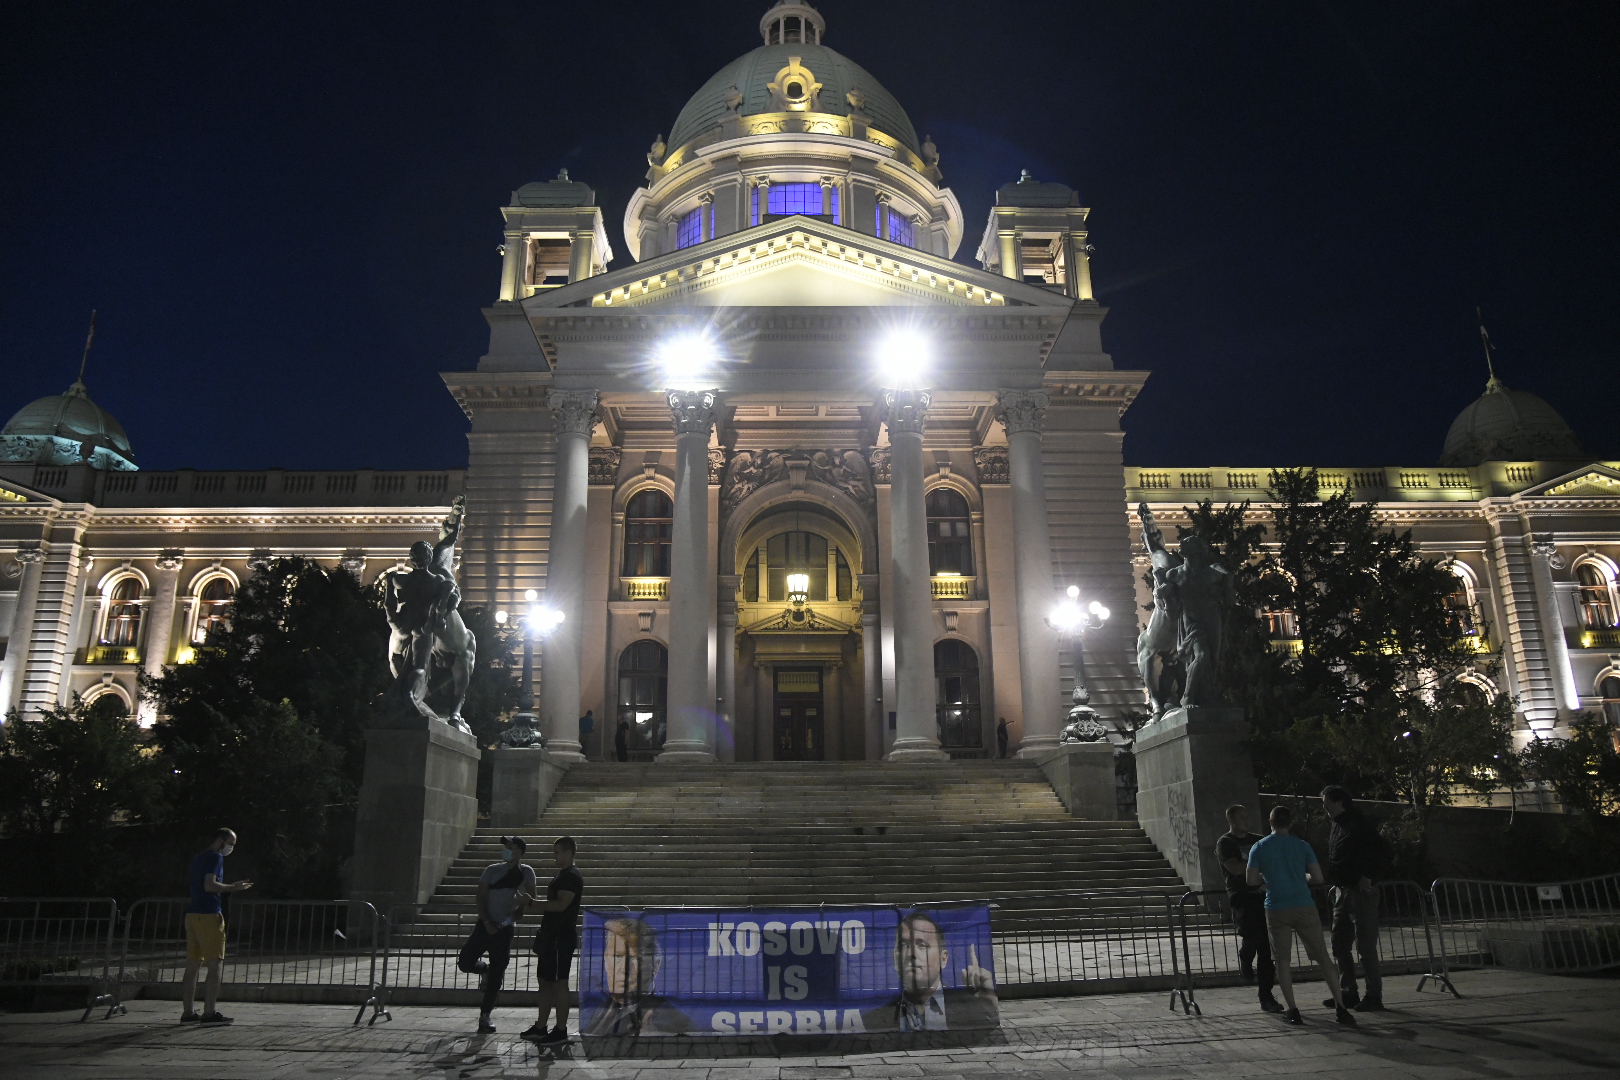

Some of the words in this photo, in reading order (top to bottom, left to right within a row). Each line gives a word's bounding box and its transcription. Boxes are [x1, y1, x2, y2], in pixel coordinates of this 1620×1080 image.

[708, 920, 866, 956] KOSOVO
[767, 965, 809, 1000] IS
[711, 1008, 868, 1036] SERBIA
